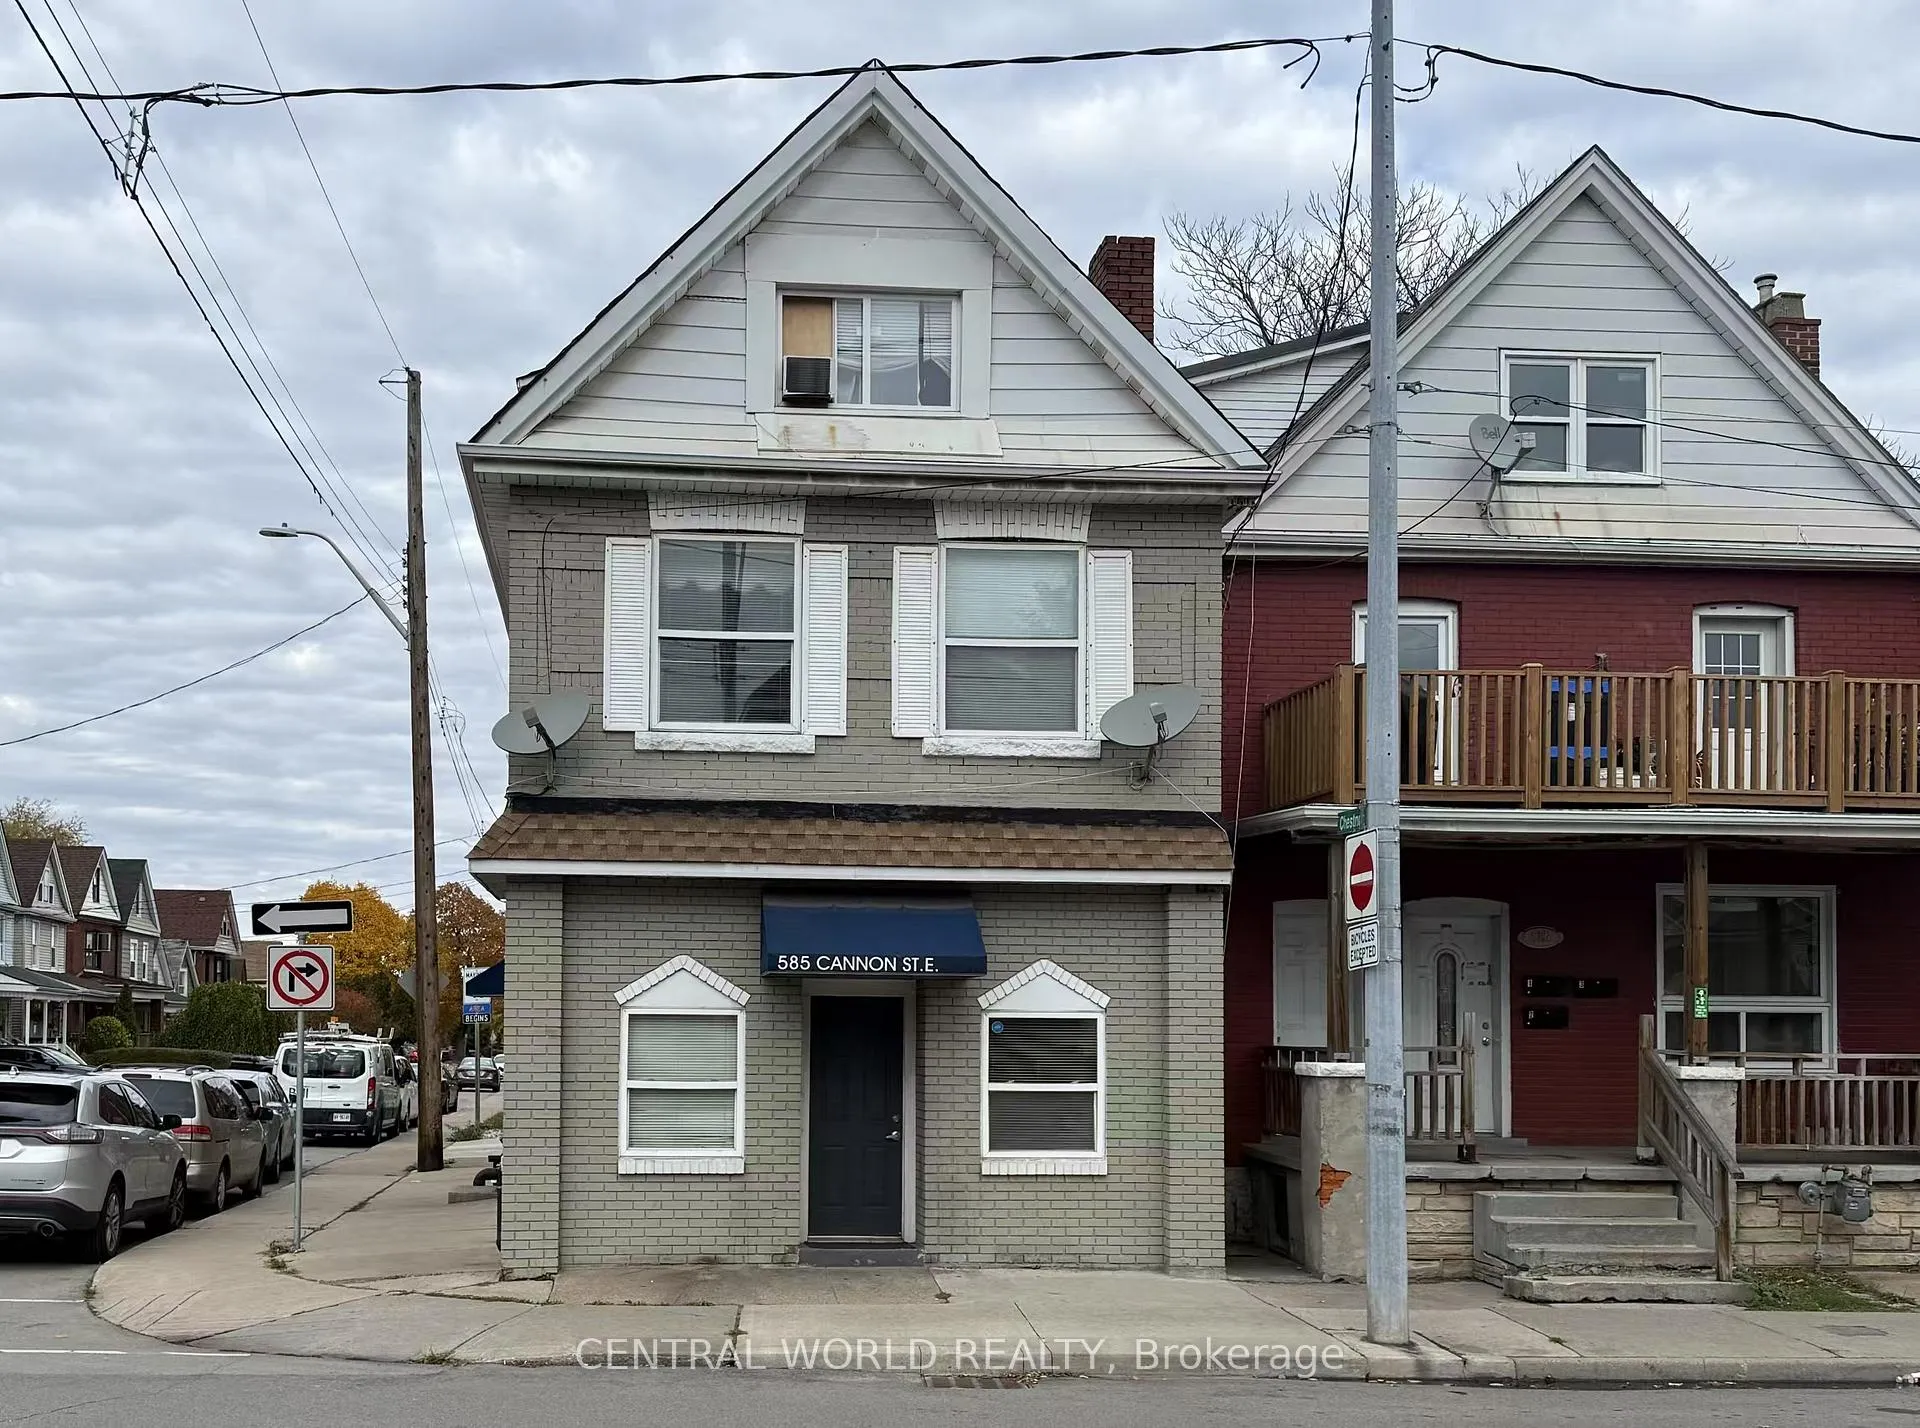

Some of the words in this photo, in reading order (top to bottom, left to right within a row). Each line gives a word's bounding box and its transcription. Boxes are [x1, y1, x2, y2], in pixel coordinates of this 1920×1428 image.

[1481, 427, 1500, 439] Bell
[1351, 928, 1375, 946] BICYCLES
[1351, 945, 1376, 962] EXCEPTED
[777, 955, 811, 970] 585
[816, 955, 897, 971] CANNON
[465, 1014, 489, 1022] BEGINS
